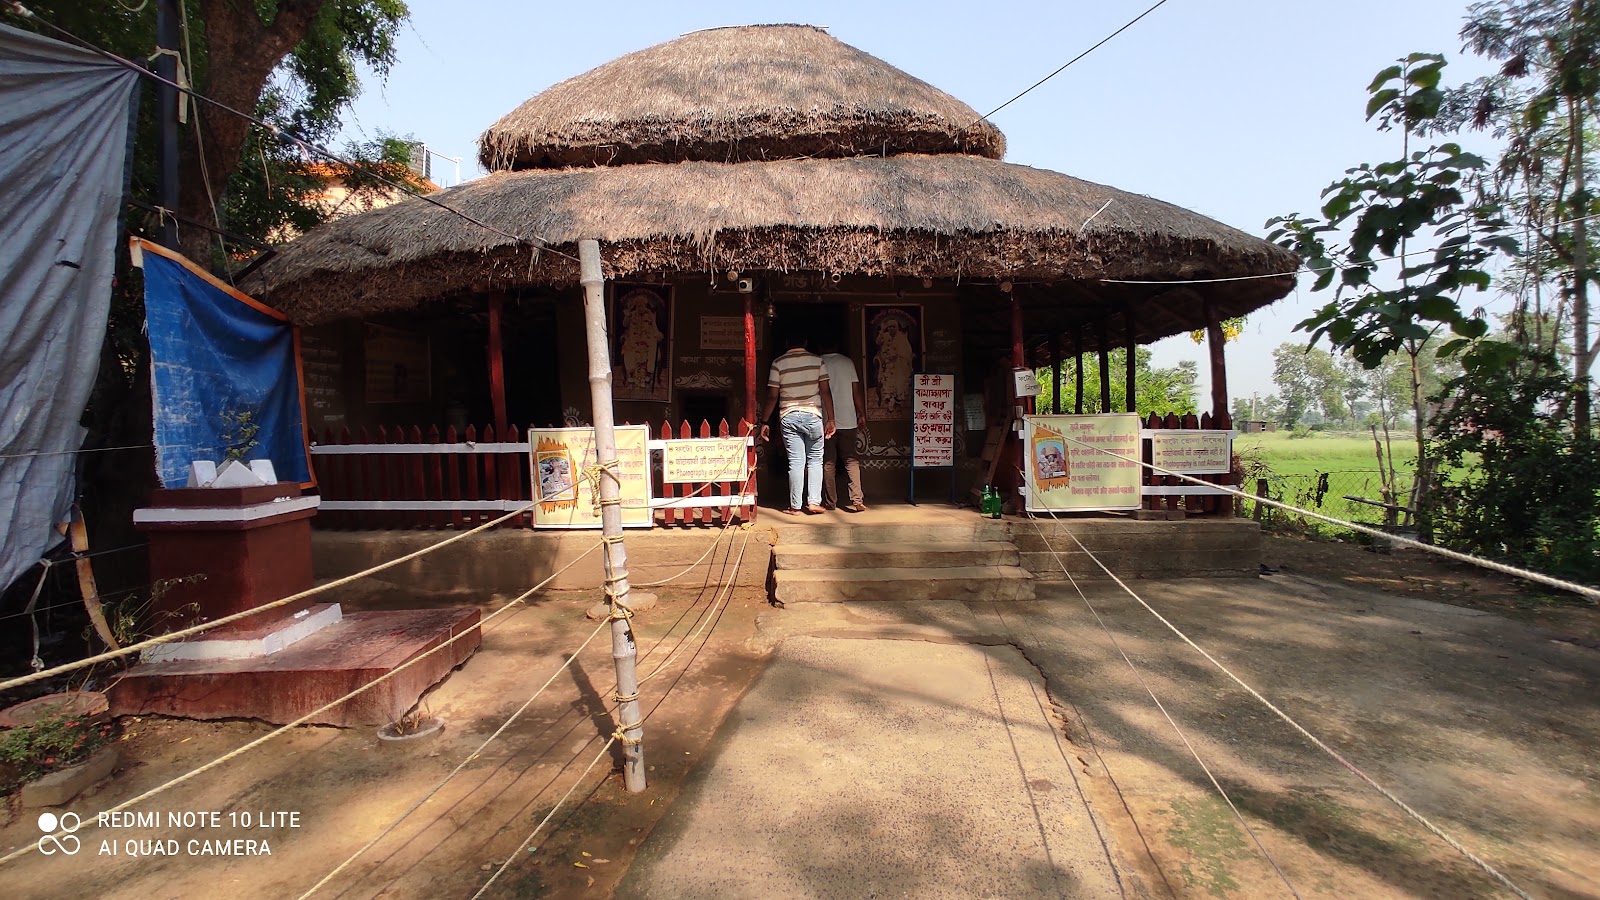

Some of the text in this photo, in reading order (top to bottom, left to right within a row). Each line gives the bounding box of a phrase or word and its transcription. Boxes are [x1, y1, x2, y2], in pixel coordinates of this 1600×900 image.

[919, 374, 942, 386] শ্রী শ্রী
[921, 400, 946, 410] বাবার
[915, 434, 932, 444] দর্শন
[1163, 460, 1192, 469] Photography
[1207, 459, 1225, 467] Allowed
